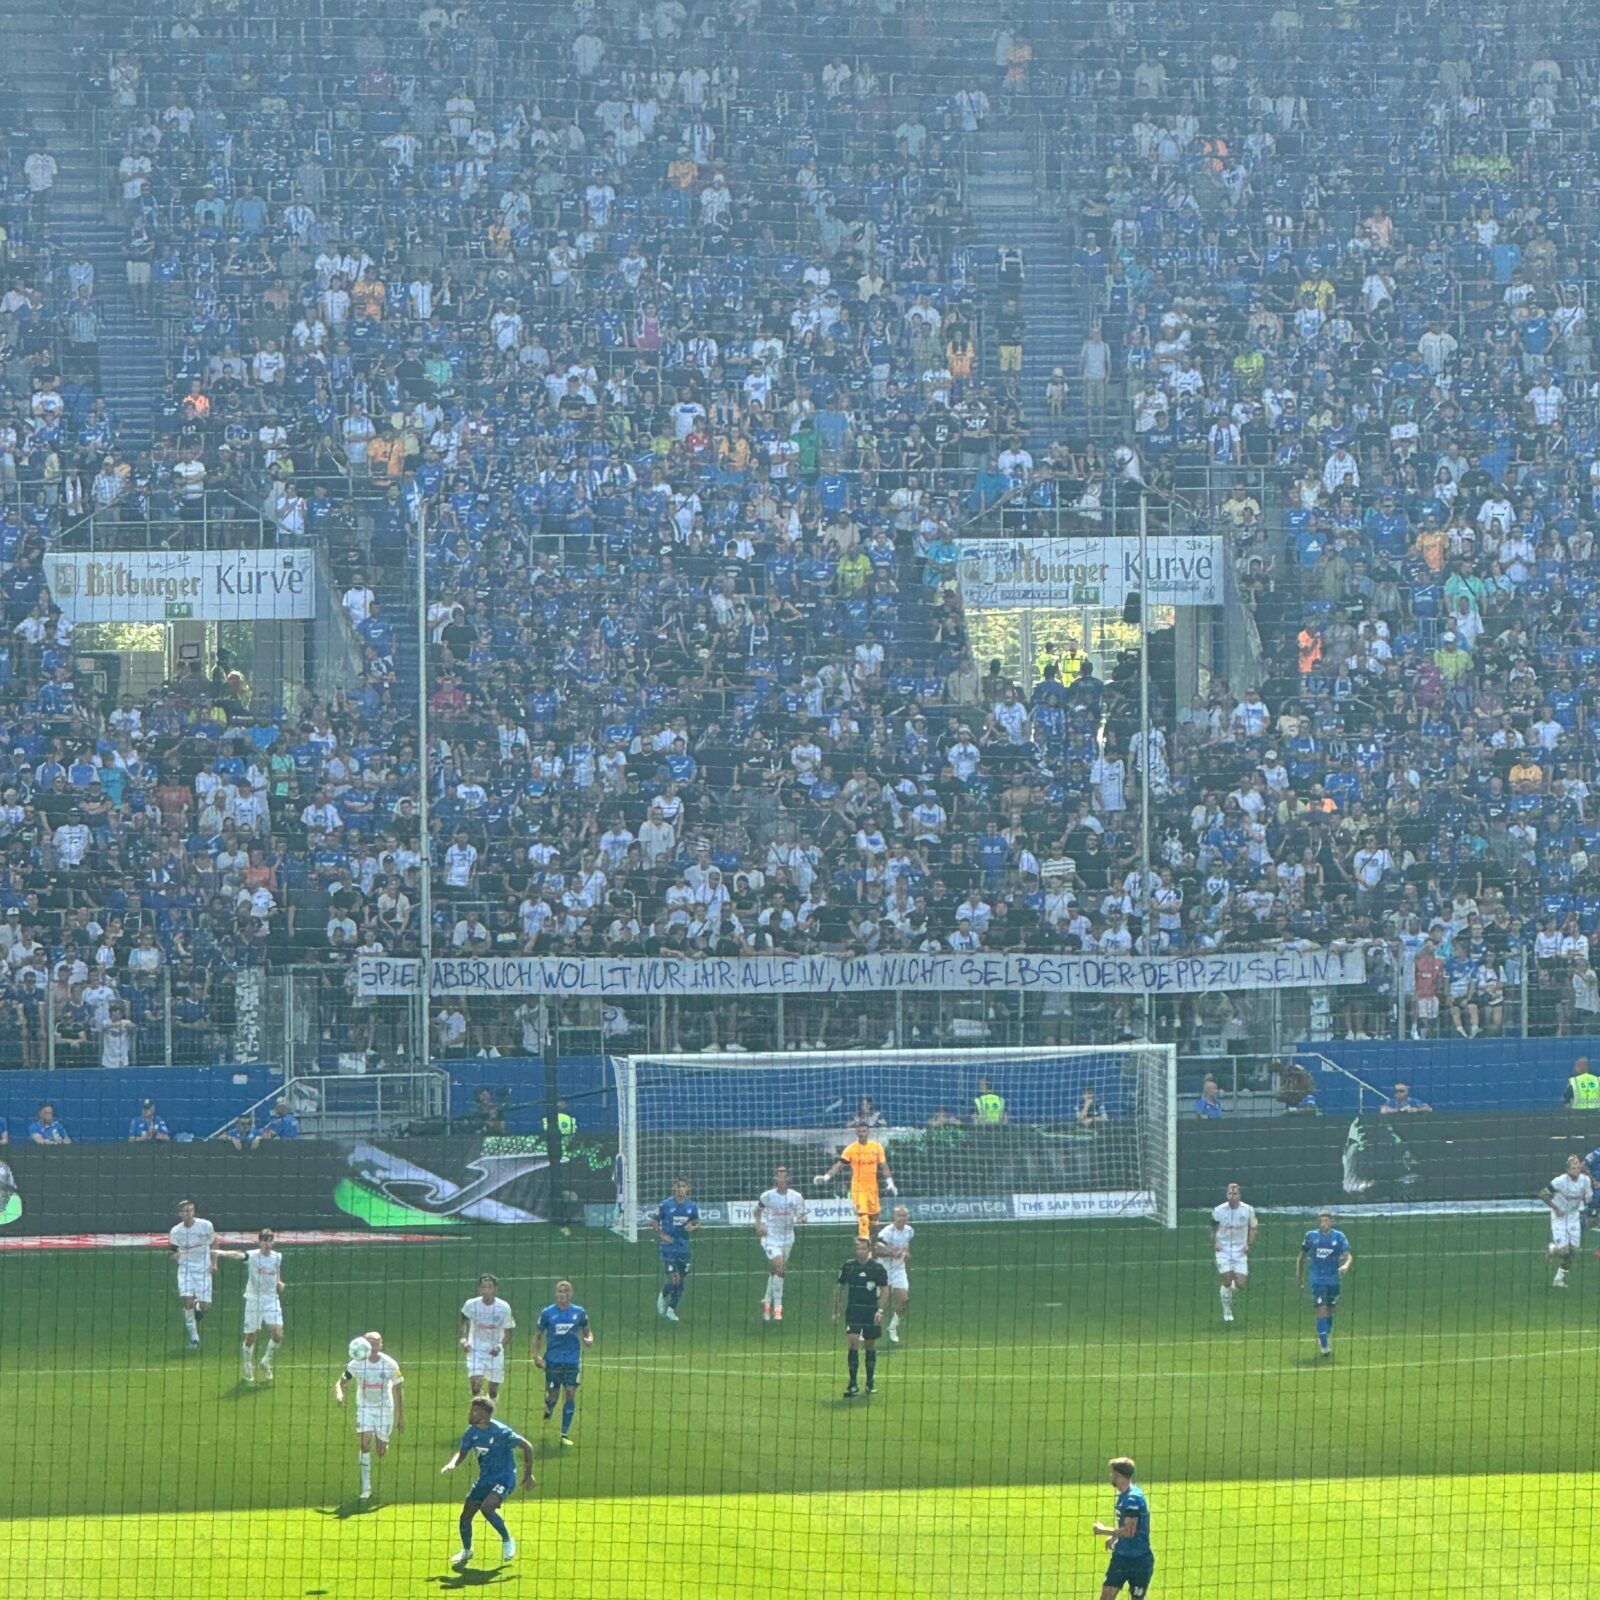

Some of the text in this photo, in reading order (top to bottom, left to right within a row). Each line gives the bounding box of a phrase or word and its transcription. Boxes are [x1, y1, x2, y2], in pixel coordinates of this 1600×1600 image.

[85, 561, 202, 601] Bitburger
[216, 564, 304, 595] Kurve
[1124, 551, 1213, 581] Kurve
[1022, 1201, 1044, 1212] THE
[1046, 1200, 1071, 1211] SAP
